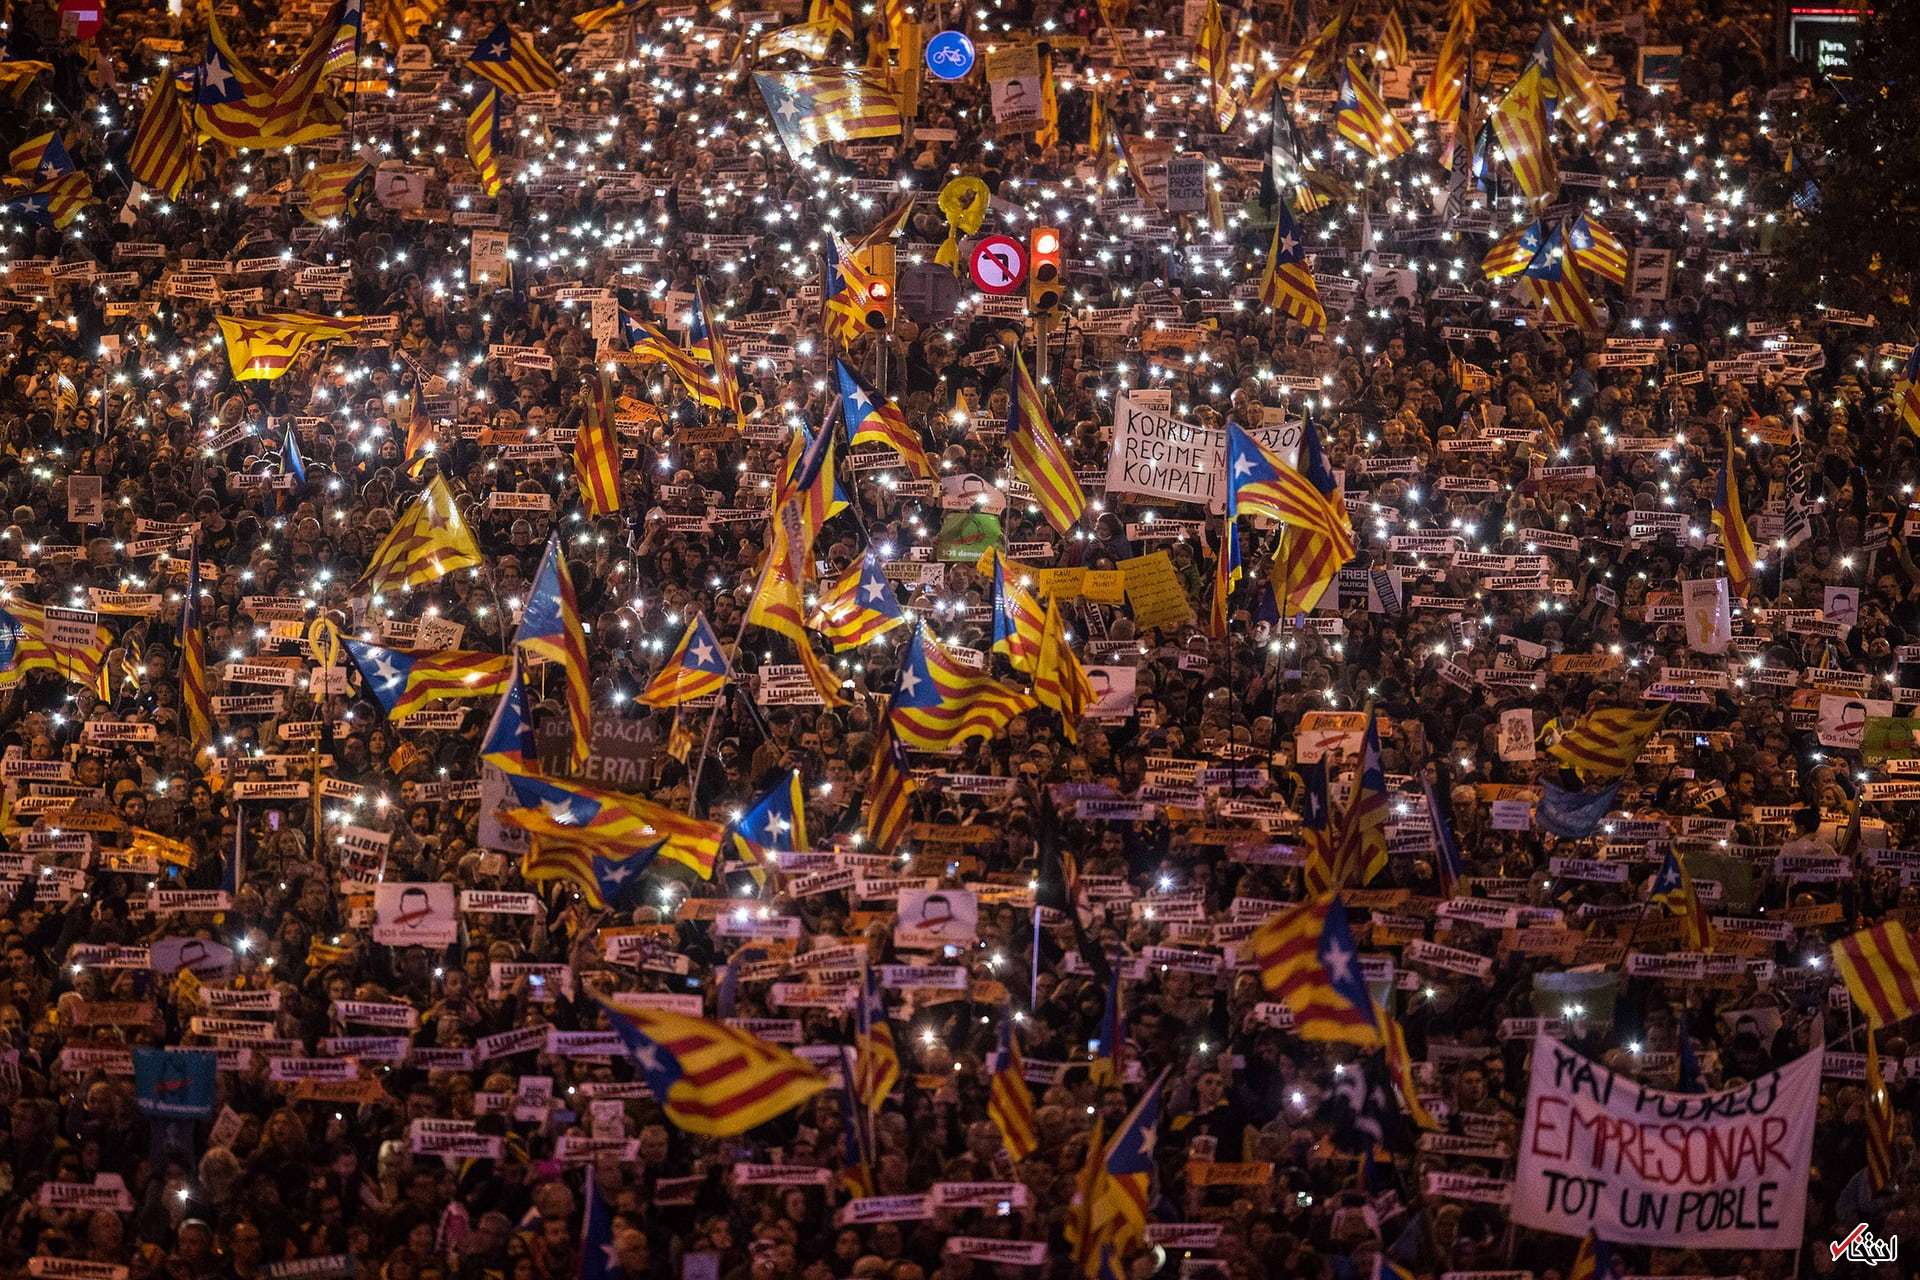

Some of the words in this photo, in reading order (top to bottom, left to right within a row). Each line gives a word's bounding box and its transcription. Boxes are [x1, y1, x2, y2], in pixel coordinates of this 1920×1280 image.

[1125, 438, 1206, 467] REGIME
[854, 453, 900, 465] LLIBERTAT
[1459, 554, 1507, 562] LLIBERTAT
[1340, 569, 1368, 580] FREE
[45, 611, 96, 623] LLIBERTAT
[57, 625, 90, 635] PRESOS
[233, 665, 286, 677] LLIBERTAT
[1814, 670, 1865, 682] LLIBERTAT
[220, 697, 274, 706] LLIBERTAT
[405, 713, 458, 722] LLIBERTAT
[1821, 734, 1838, 742] SOS
[6, 761, 61, 771] LLIBERTAT
[243, 783, 299, 791] LLIBERTAT
[28, 833, 86, 843] LLIBERTAT
[1554, 1049, 1614, 1105] MAI
[1532, 1096, 1791, 1186] EMPRESONAR
[1543, 1170, 1606, 1220] TOT
[1619, 1188, 1668, 1230] UN
[1675, 1182, 1779, 1233] POBLE
